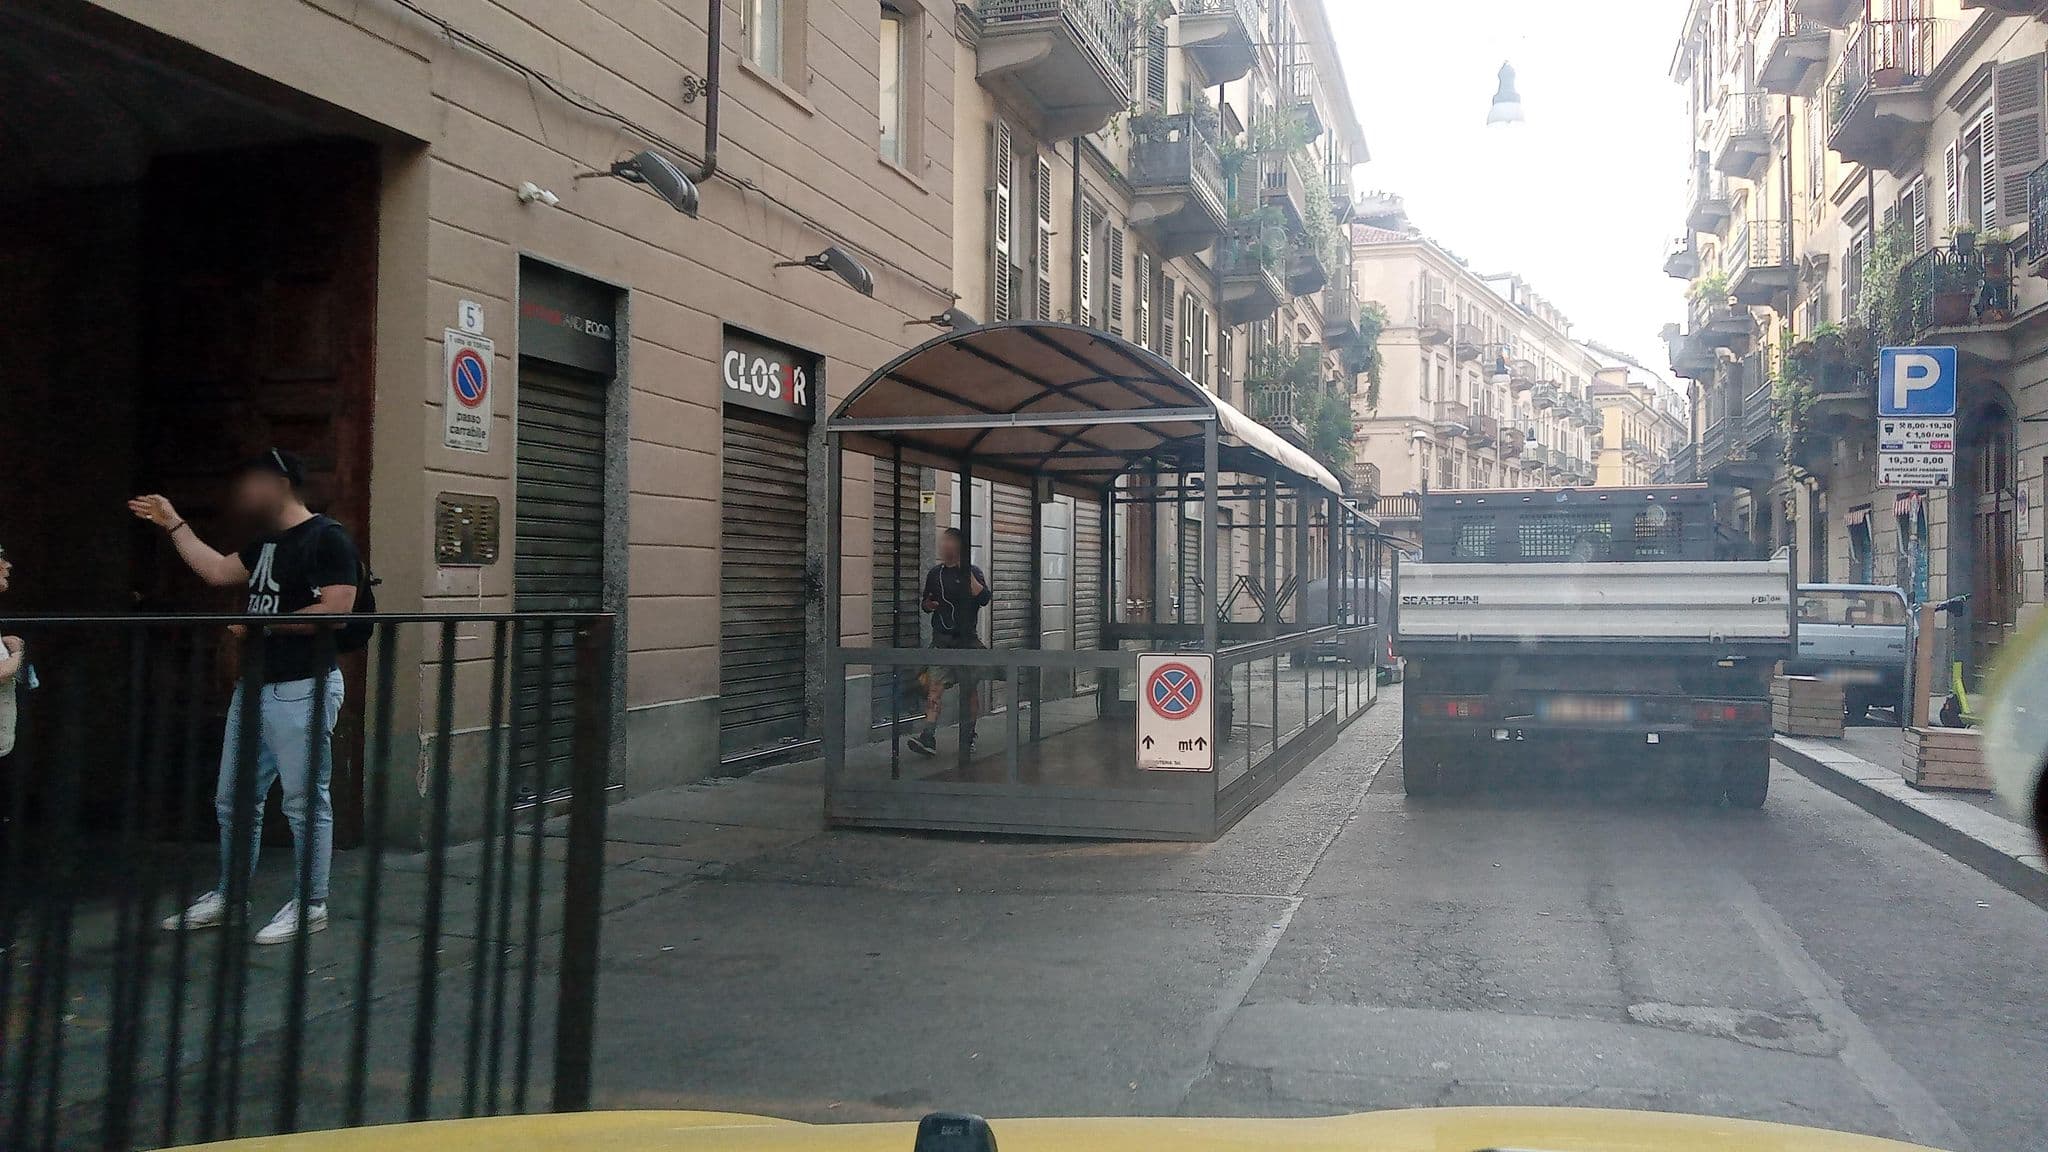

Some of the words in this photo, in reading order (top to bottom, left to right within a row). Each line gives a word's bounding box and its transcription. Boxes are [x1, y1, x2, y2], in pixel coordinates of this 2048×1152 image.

[466, 306, 475, 328] 5
[1894, 354, 1941, 409] P
[1889, 456, 1914, 465] 19,30
[1922, 456, 1944, 465] 8,00
[1402, 595, 1479, 606] SCATTOLINI
[1178, 739, 1193, 752] mt
